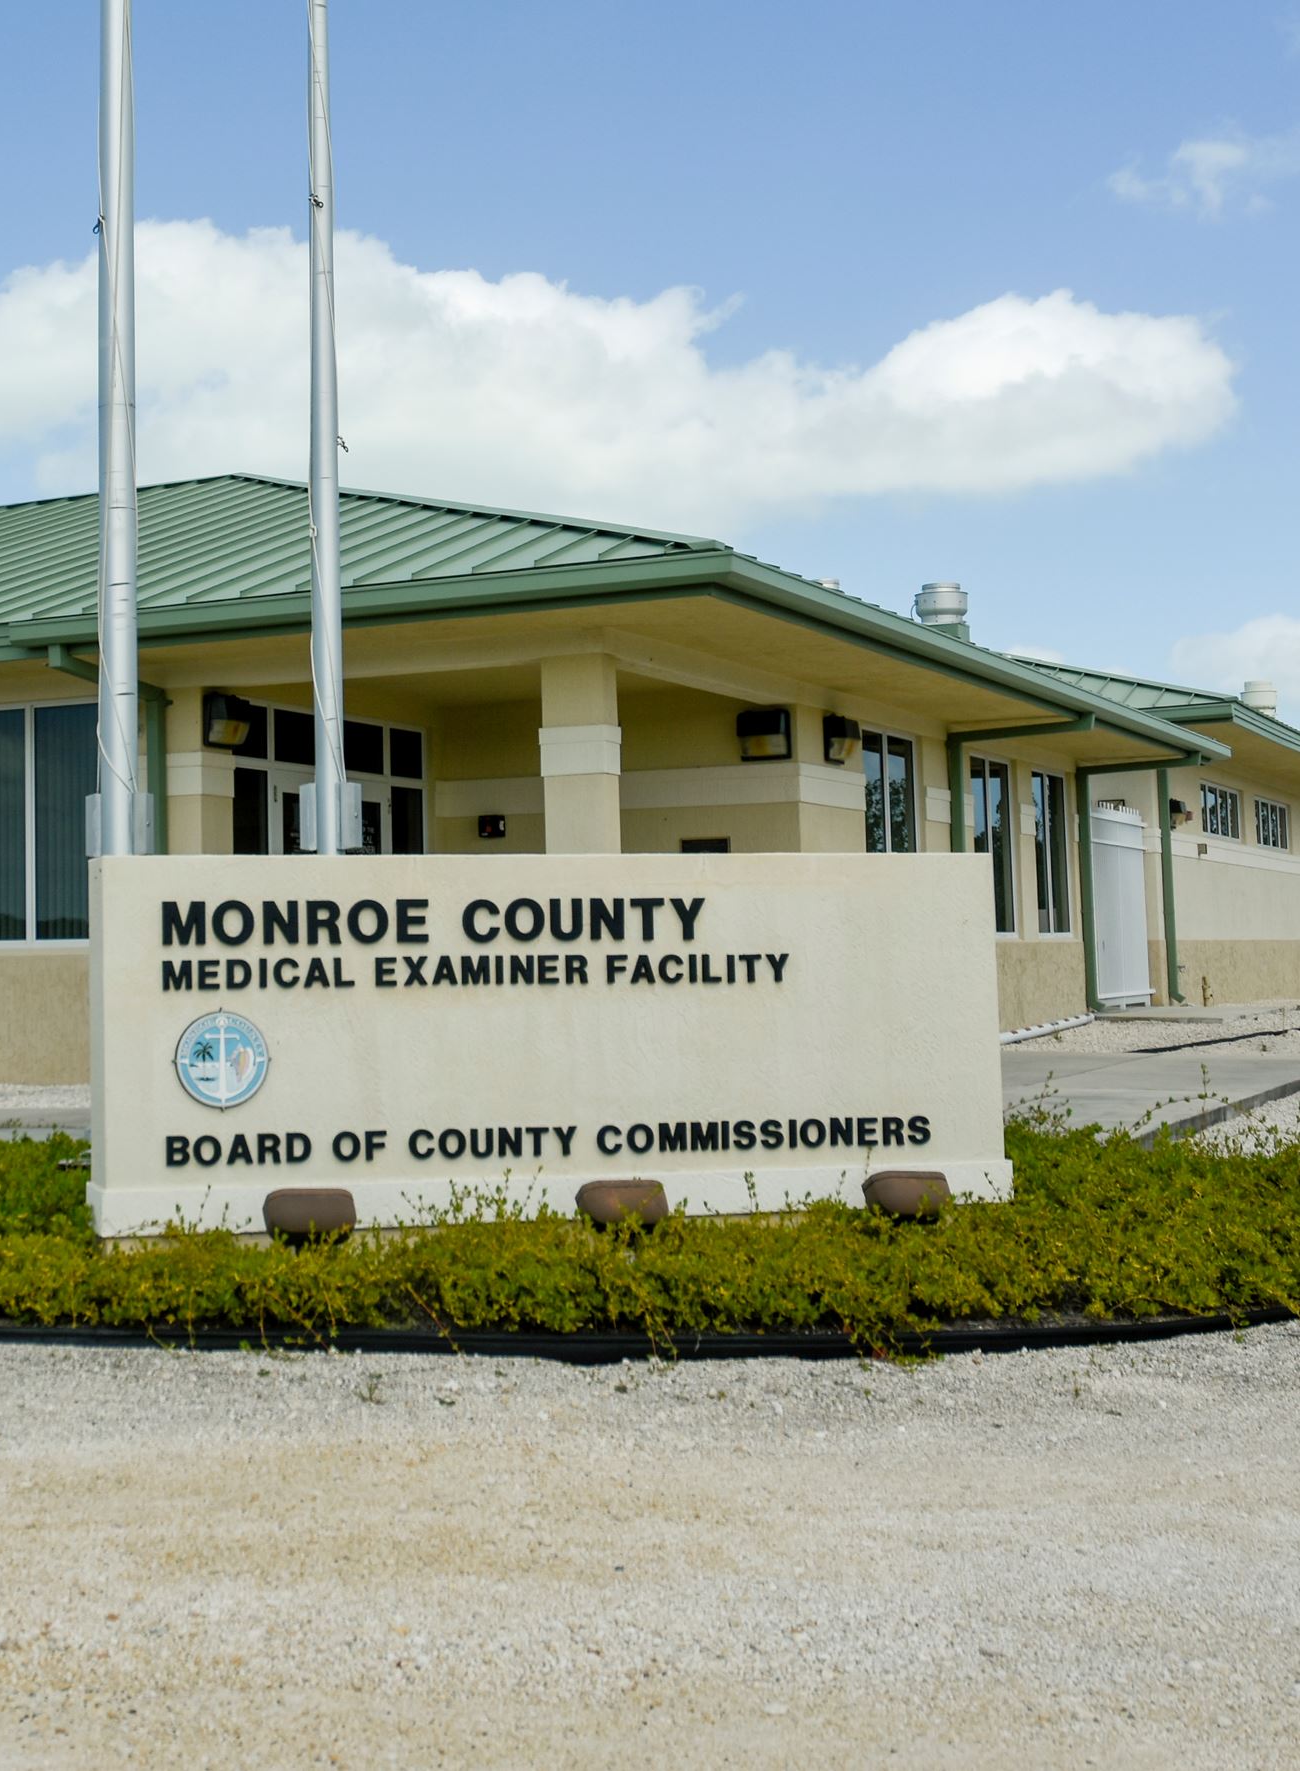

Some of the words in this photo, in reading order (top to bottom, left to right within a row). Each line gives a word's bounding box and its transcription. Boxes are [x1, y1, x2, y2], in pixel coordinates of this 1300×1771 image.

[161, 898, 430, 948] MONROE
[461, 897, 706, 945] COUNTY
[161, 957, 356, 992] MEDICAL
[374, 954, 589, 988] EXAMINER
[605, 953, 790, 985] FACILITY
[165, 1132, 312, 1168] BOARD
[331, 1130, 388, 1164] OF
[407, 1125, 578, 1161] COUNTY
[596, 1115, 932, 1157] COMMISSIONERS
